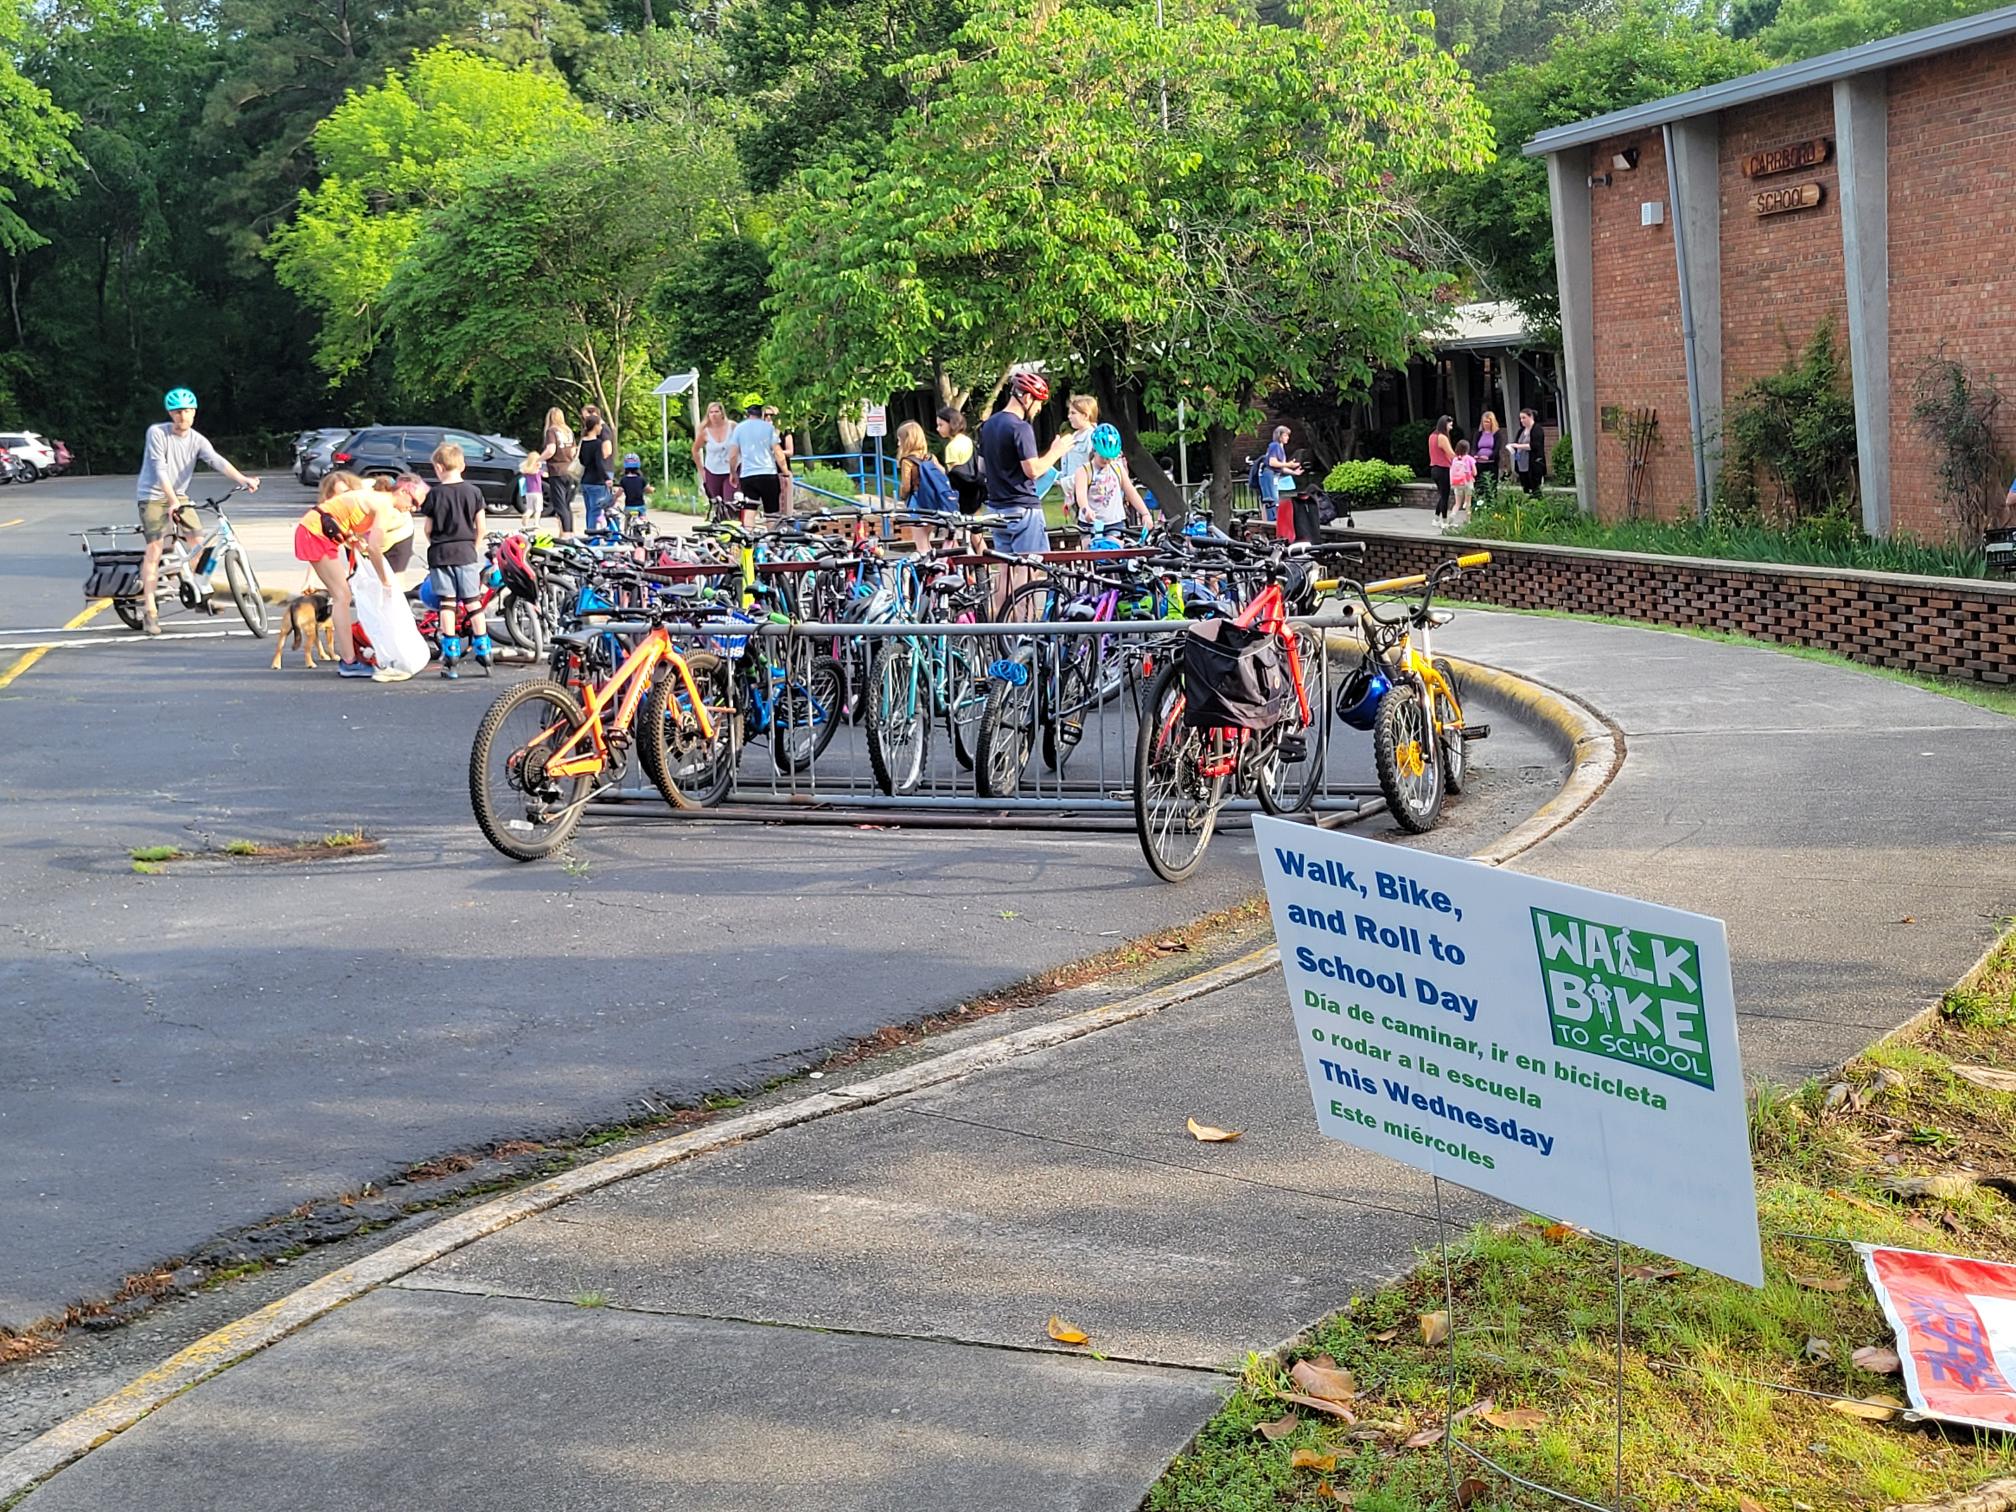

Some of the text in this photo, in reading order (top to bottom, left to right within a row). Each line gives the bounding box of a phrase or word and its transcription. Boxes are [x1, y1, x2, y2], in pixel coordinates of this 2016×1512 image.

[1757, 185, 1809, 213] SCHOOL
[1275, 847, 1462, 922] Walk, Bike,
[1288, 904, 1466, 965] and Roll to
[1537, 912, 1698, 994] WALK
[1296, 946, 1478, 1022] School Day
[1304, 989, 1667, 1110] Día de caminar, ir en bicicleta
[1312, 1028, 1542, 1109] o rodar a la escuela
[1557, 1024, 1707, 1077] TO SCHOOL
[1319, 1059, 1554, 1156] This Wednesday
[1330, 1100, 1495, 1170] Este miércoles
